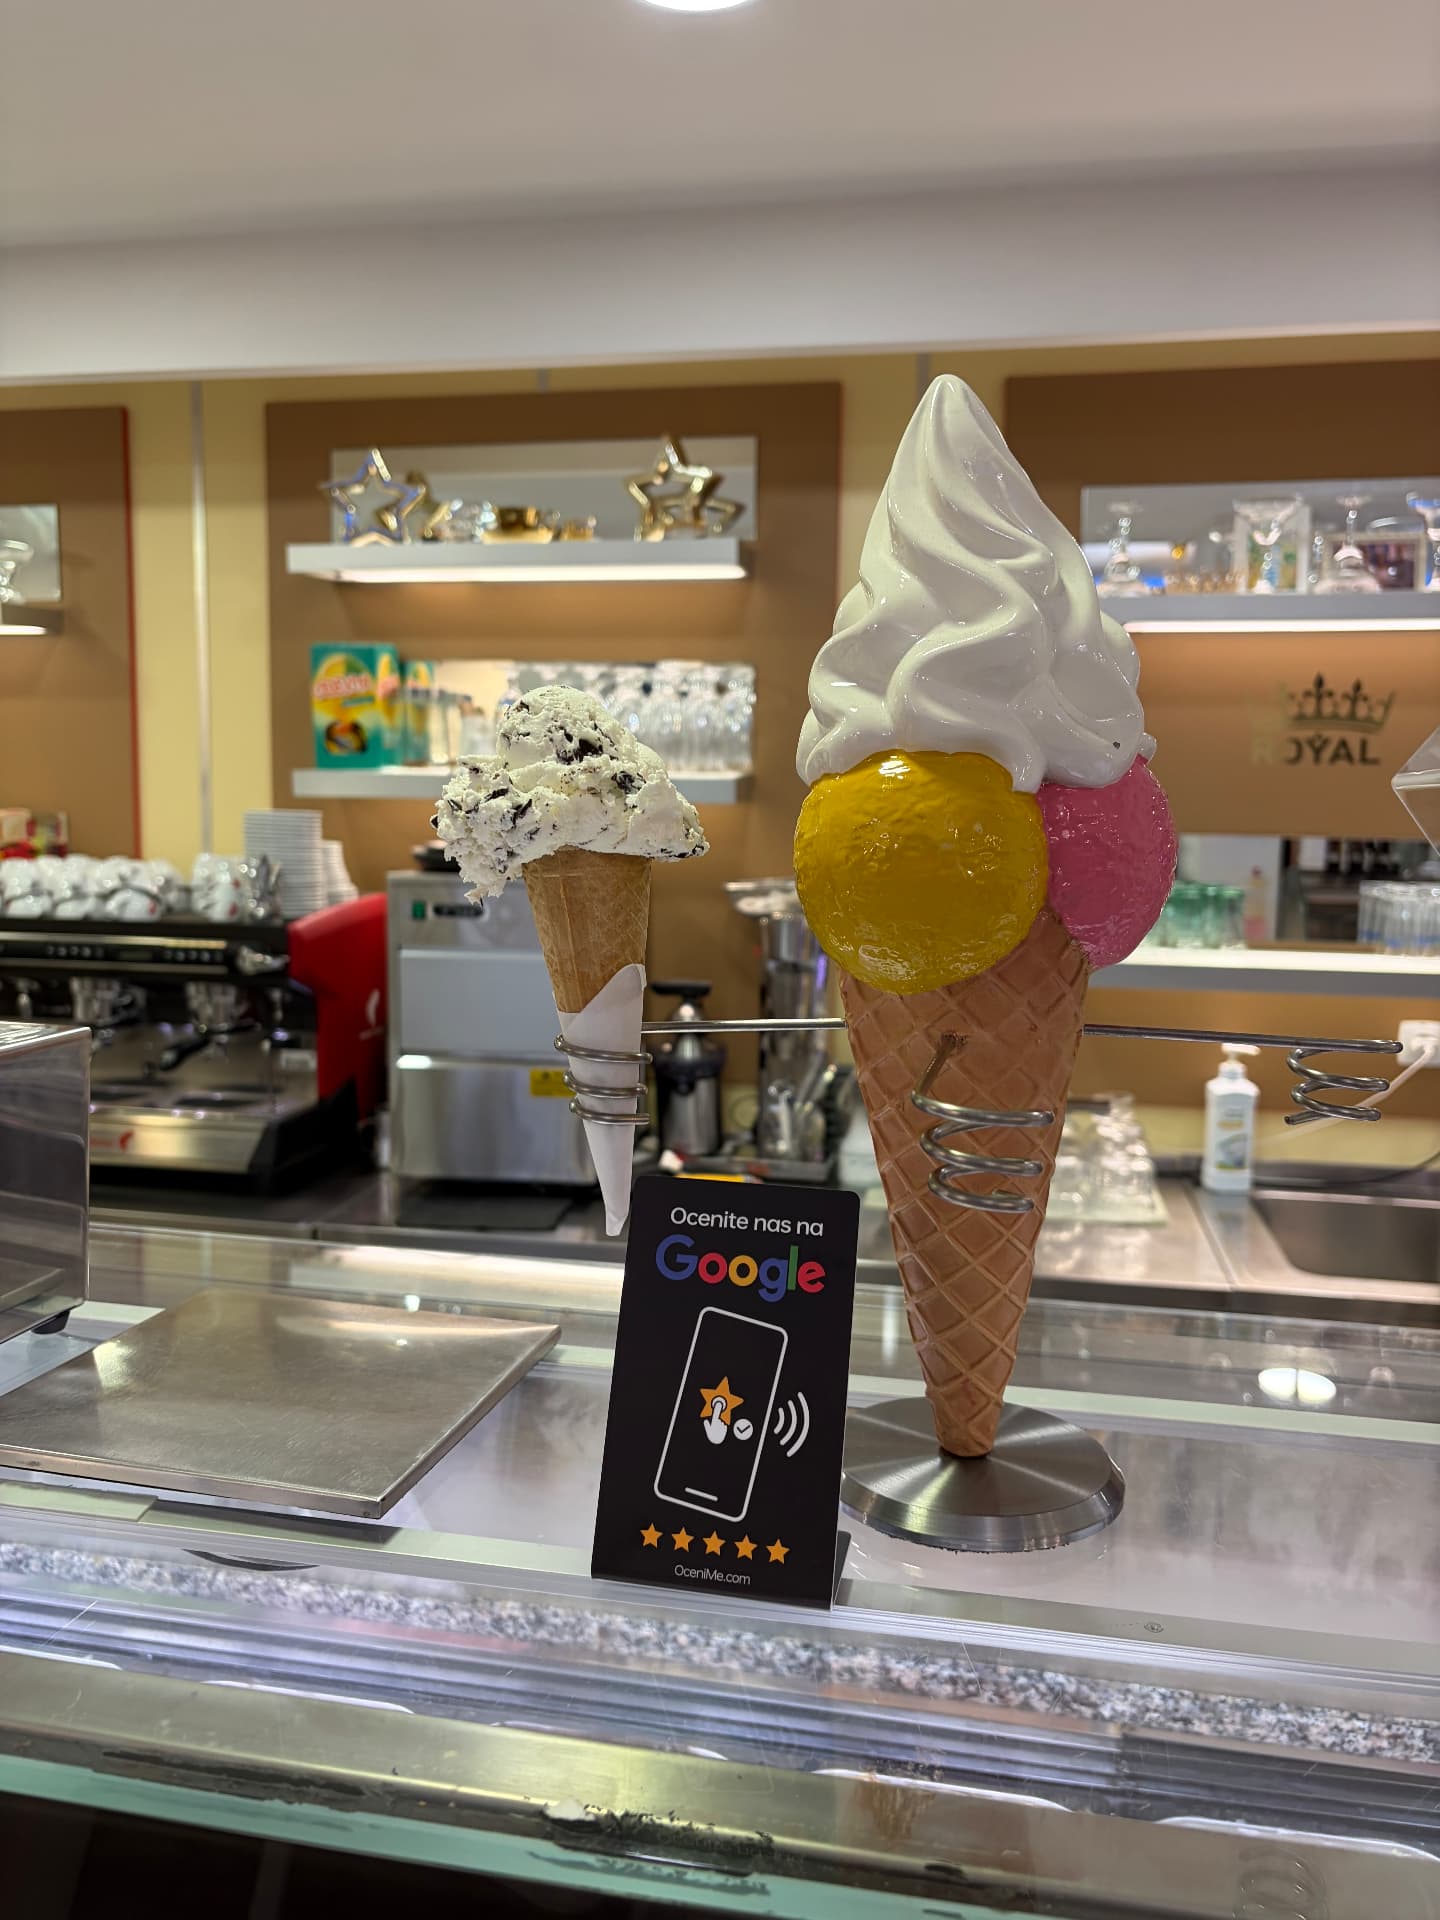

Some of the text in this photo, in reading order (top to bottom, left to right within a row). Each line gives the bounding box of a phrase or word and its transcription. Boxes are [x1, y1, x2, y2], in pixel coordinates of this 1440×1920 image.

[670, 1207, 824, 1237] Ocenite nas na
[655, 1234, 826, 1303] Google
[674, 1564, 751, 1586] OceniMe.com
